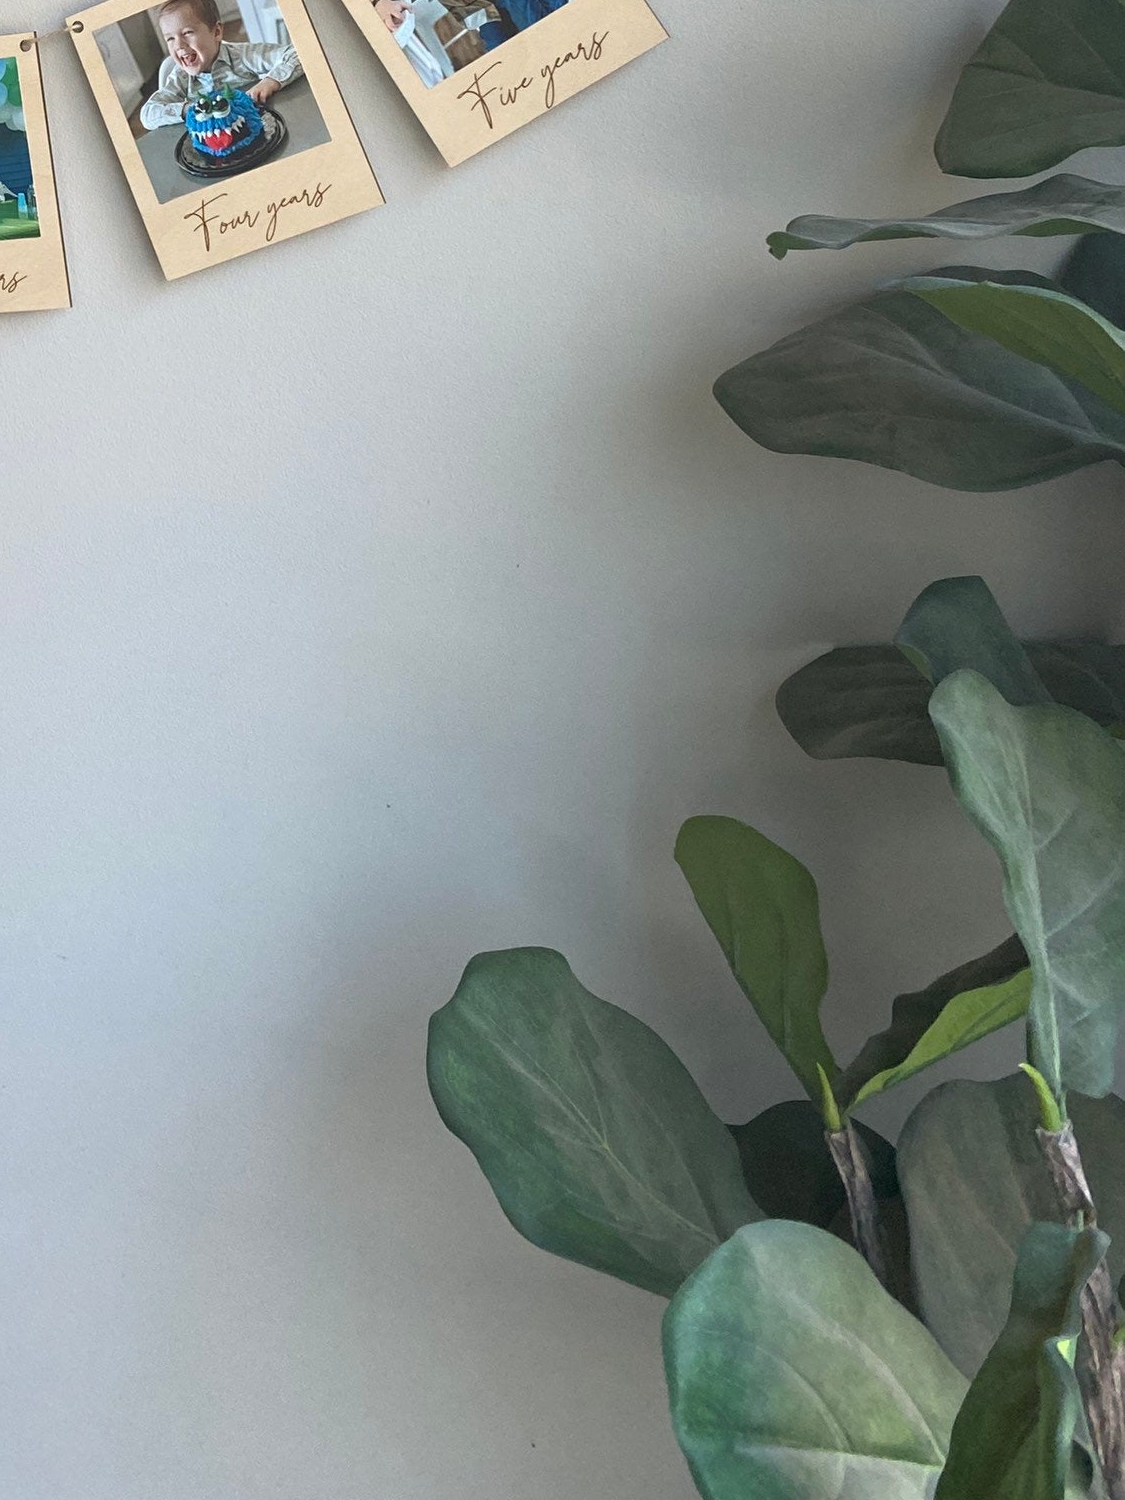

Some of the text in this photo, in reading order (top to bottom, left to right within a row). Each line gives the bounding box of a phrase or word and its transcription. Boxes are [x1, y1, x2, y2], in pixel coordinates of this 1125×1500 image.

[456, 30, 610, 130] Five years
[183, 182, 333, 252] Four years
